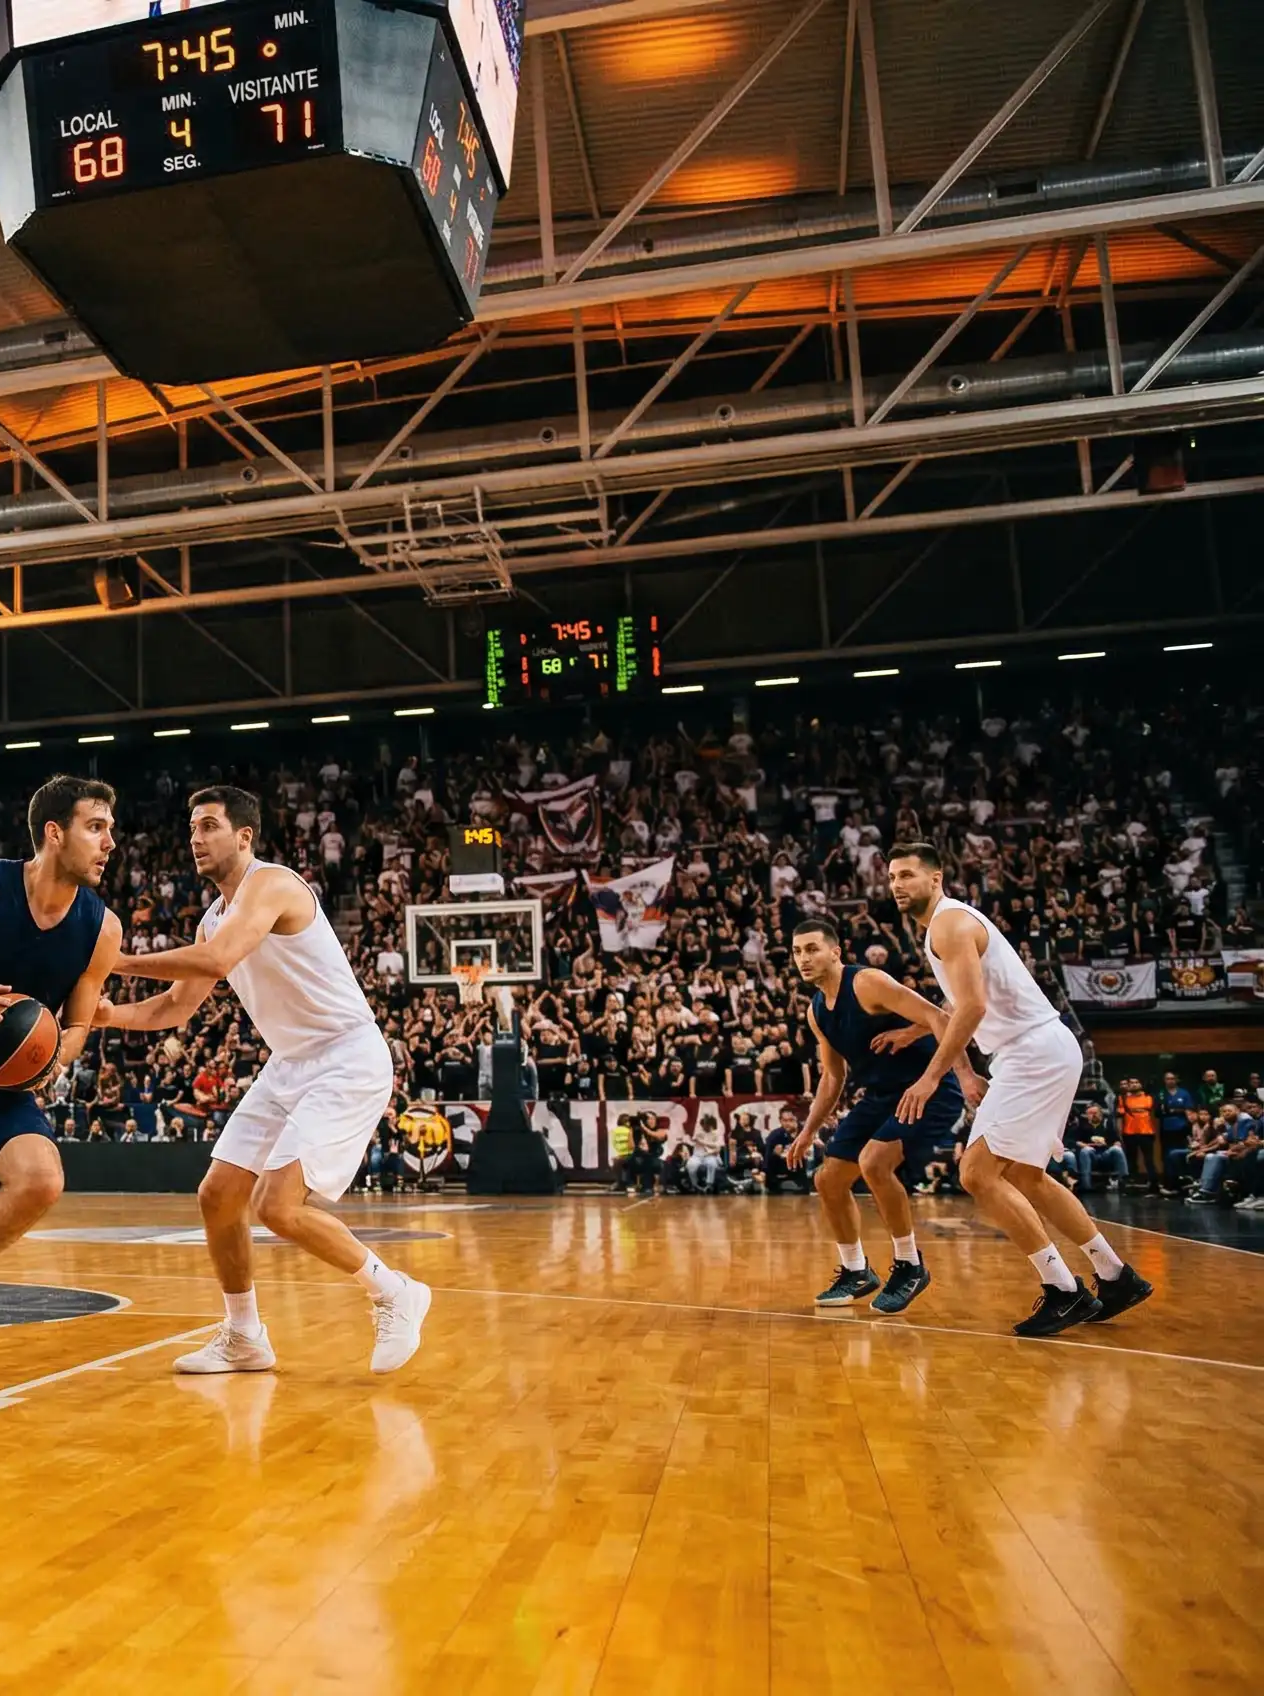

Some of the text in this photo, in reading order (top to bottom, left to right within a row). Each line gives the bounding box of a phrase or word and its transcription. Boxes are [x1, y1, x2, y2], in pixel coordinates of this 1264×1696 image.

[274, 10, 309, 29] MIN.
[142, 27, 235, 81] 7:45
[228, 68, 319, 104] VISITANTE
[162, 92, 196, 111] MIN.
[60, 110, 118, 137] LOCAL
[170, 118, 192, 147] 4
[260, 100, 312, 143] 71
[73, 136, 123, 183] 68
[163, 154, 201, 172] SEG.
[551, 620, 592, 640] 7:45
[541, 658, 562, 675] 68
